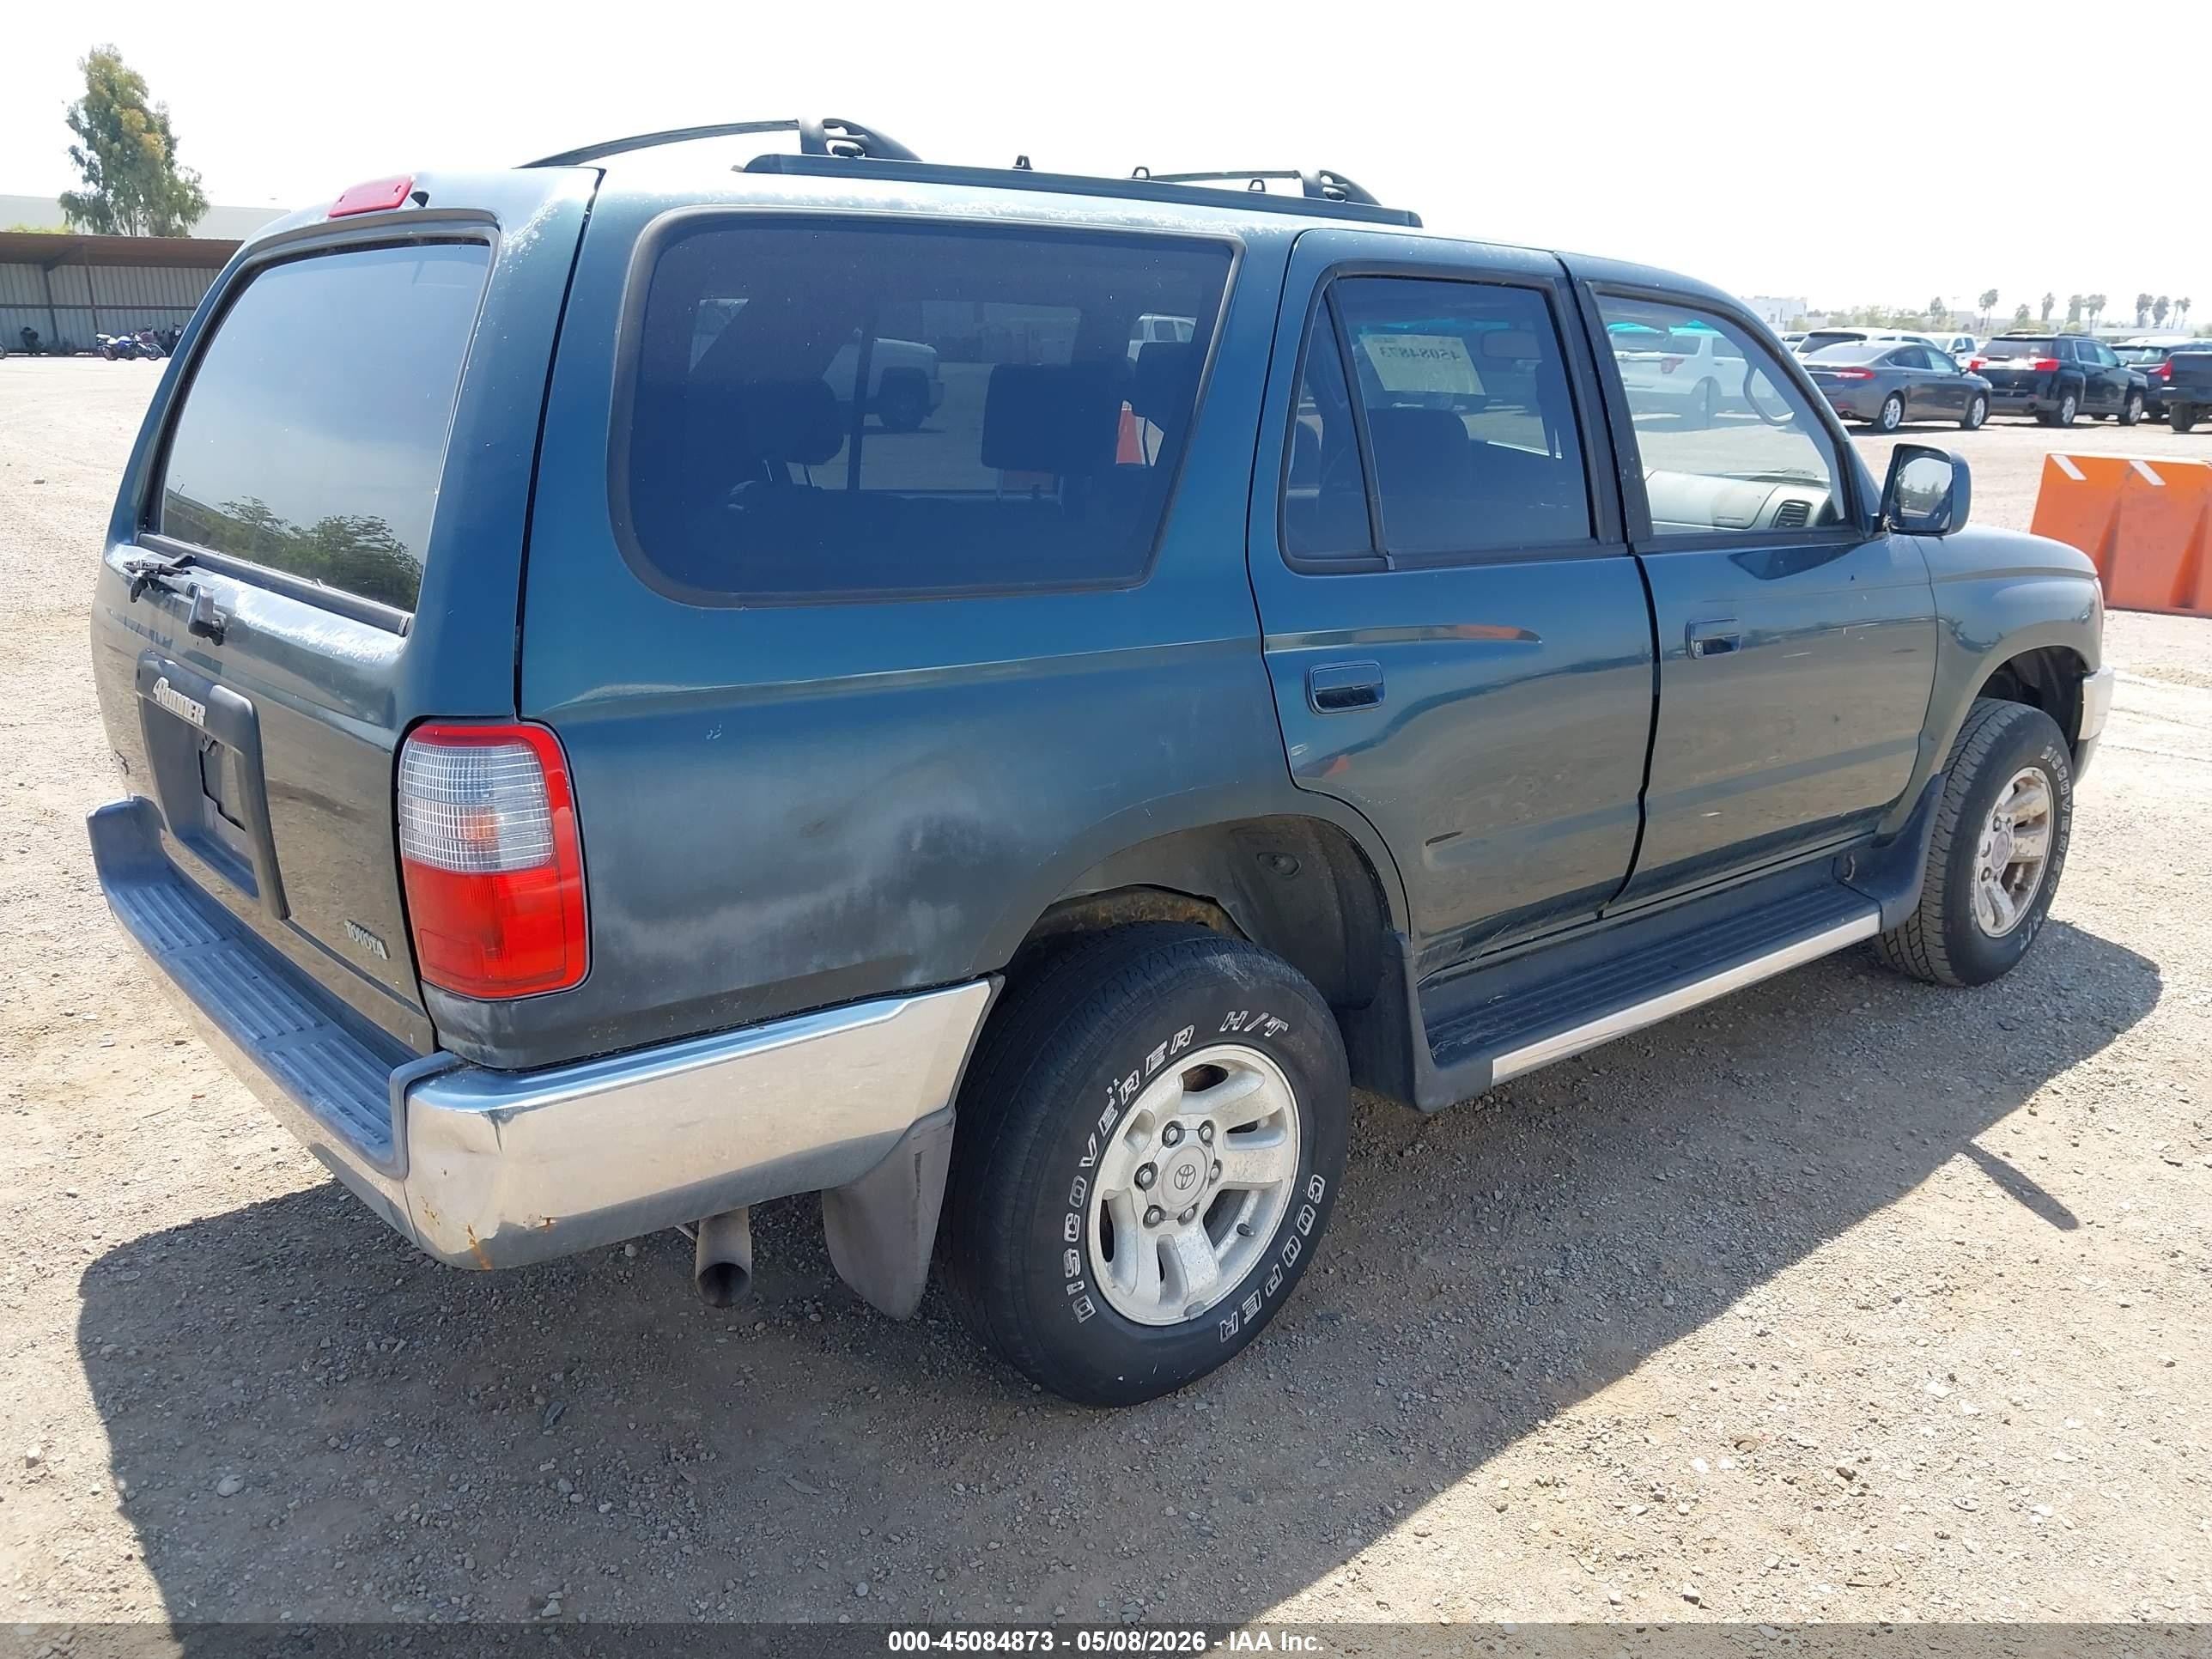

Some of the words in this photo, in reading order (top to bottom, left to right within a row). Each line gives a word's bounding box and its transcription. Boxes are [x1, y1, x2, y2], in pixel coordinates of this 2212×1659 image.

[344, 920, 390, 961] TOYOTA
[1063, 1024, 1195, 1324] DISCOVERER
[1219, 1009, 1290, 1037] H/T
[1218, 1173, 1327, 1343] COOPER
